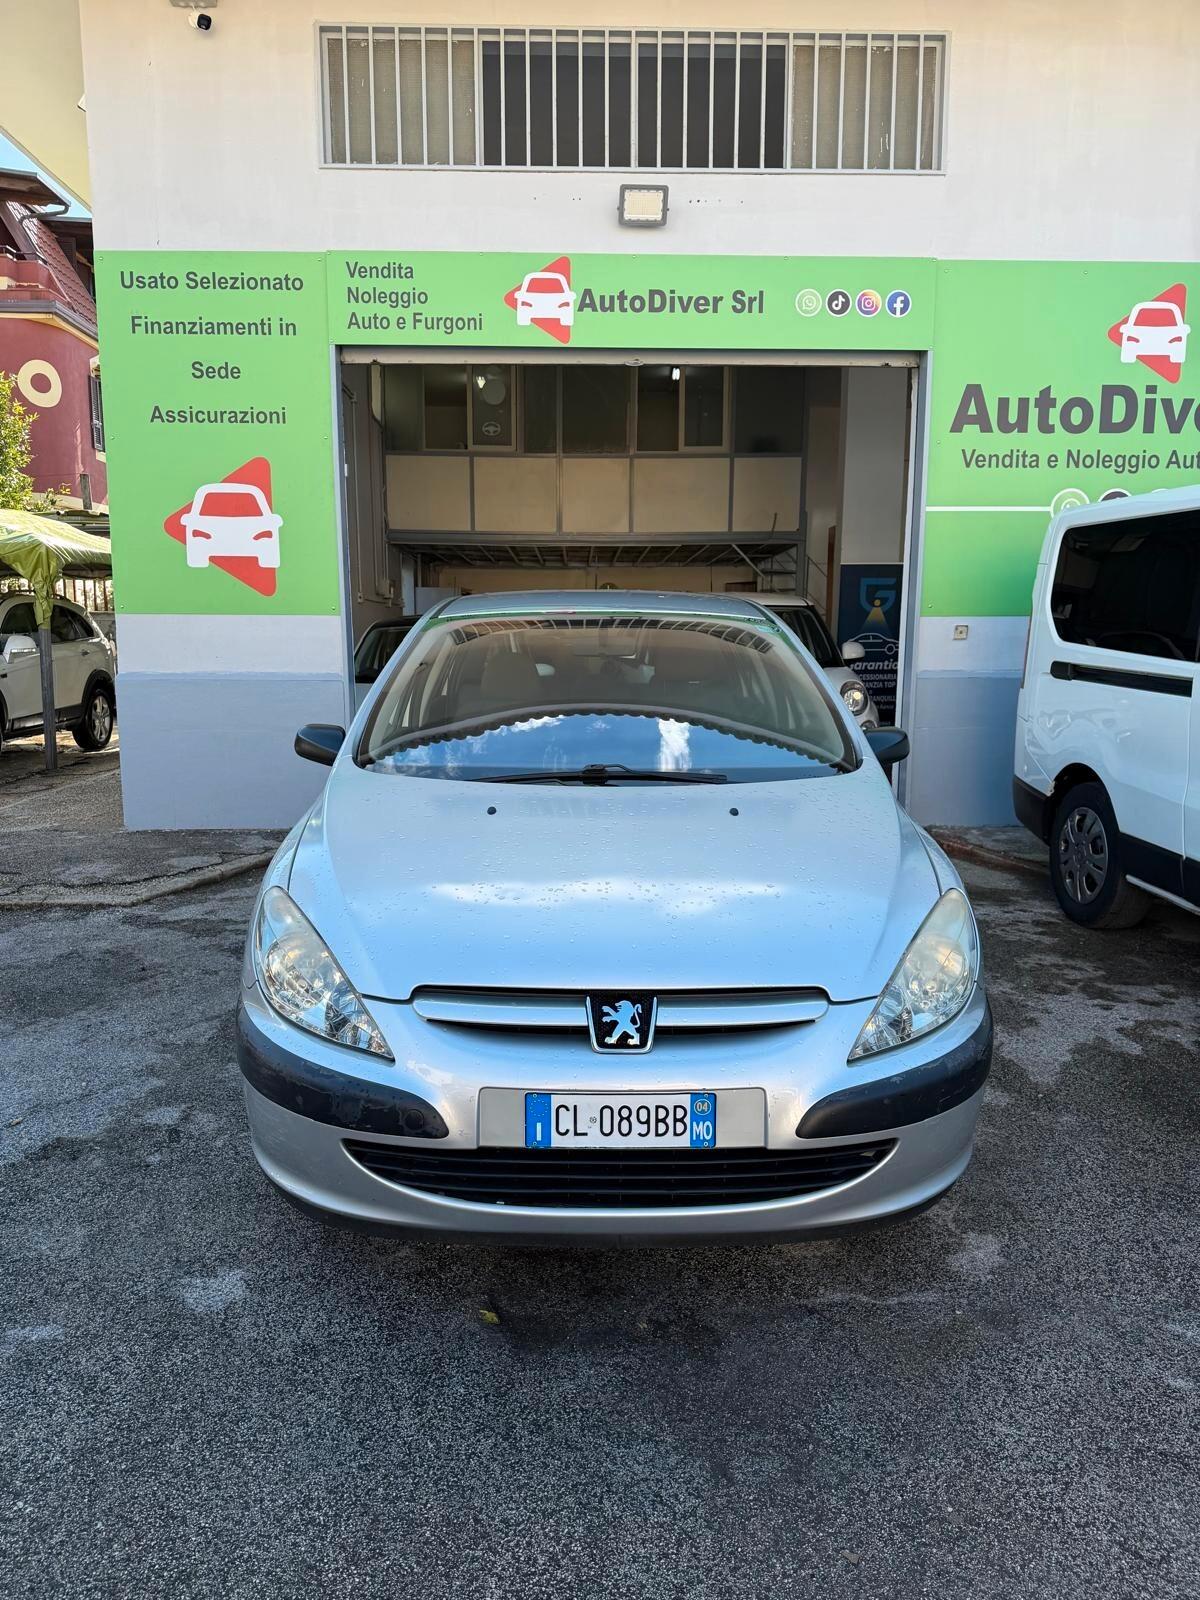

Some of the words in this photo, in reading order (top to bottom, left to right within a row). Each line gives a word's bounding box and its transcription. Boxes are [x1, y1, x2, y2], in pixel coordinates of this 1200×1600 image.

[345, 262, 414, 279] Vendita
[120, 271, 179, 290] Usato
[185, 271, 304, 291] Selezionato
[347, 287, 429, 307] Noleggio
[577, 289, 724, 314] AutoDiver
[731, 290, 764, 314] Srl
[131, 316, 272, 335] Finanziamenti
[279, 317, 297, 336] in
[347, 312, 391, 330] Auto
[396, 317, 407, 330] e
[412, 312, 483, 335] Furgoni
[191, 361, 241, 380] Sede
[150, 405, 286, 425] Assicurazioni
[949, 383, 1200, 434] AutoDiv
[961, 449, 1040, 469] Vendita
[1047, 453, 1059, 469] e
[1066, 450, 1160, 474] Noleggio
[696, 1102, 708, 1112] 04
[555, 1104, 588, 1137] CL
[599, 1104, 688, 1138] 089BB
[692, 1120, 713, 1141] MO
